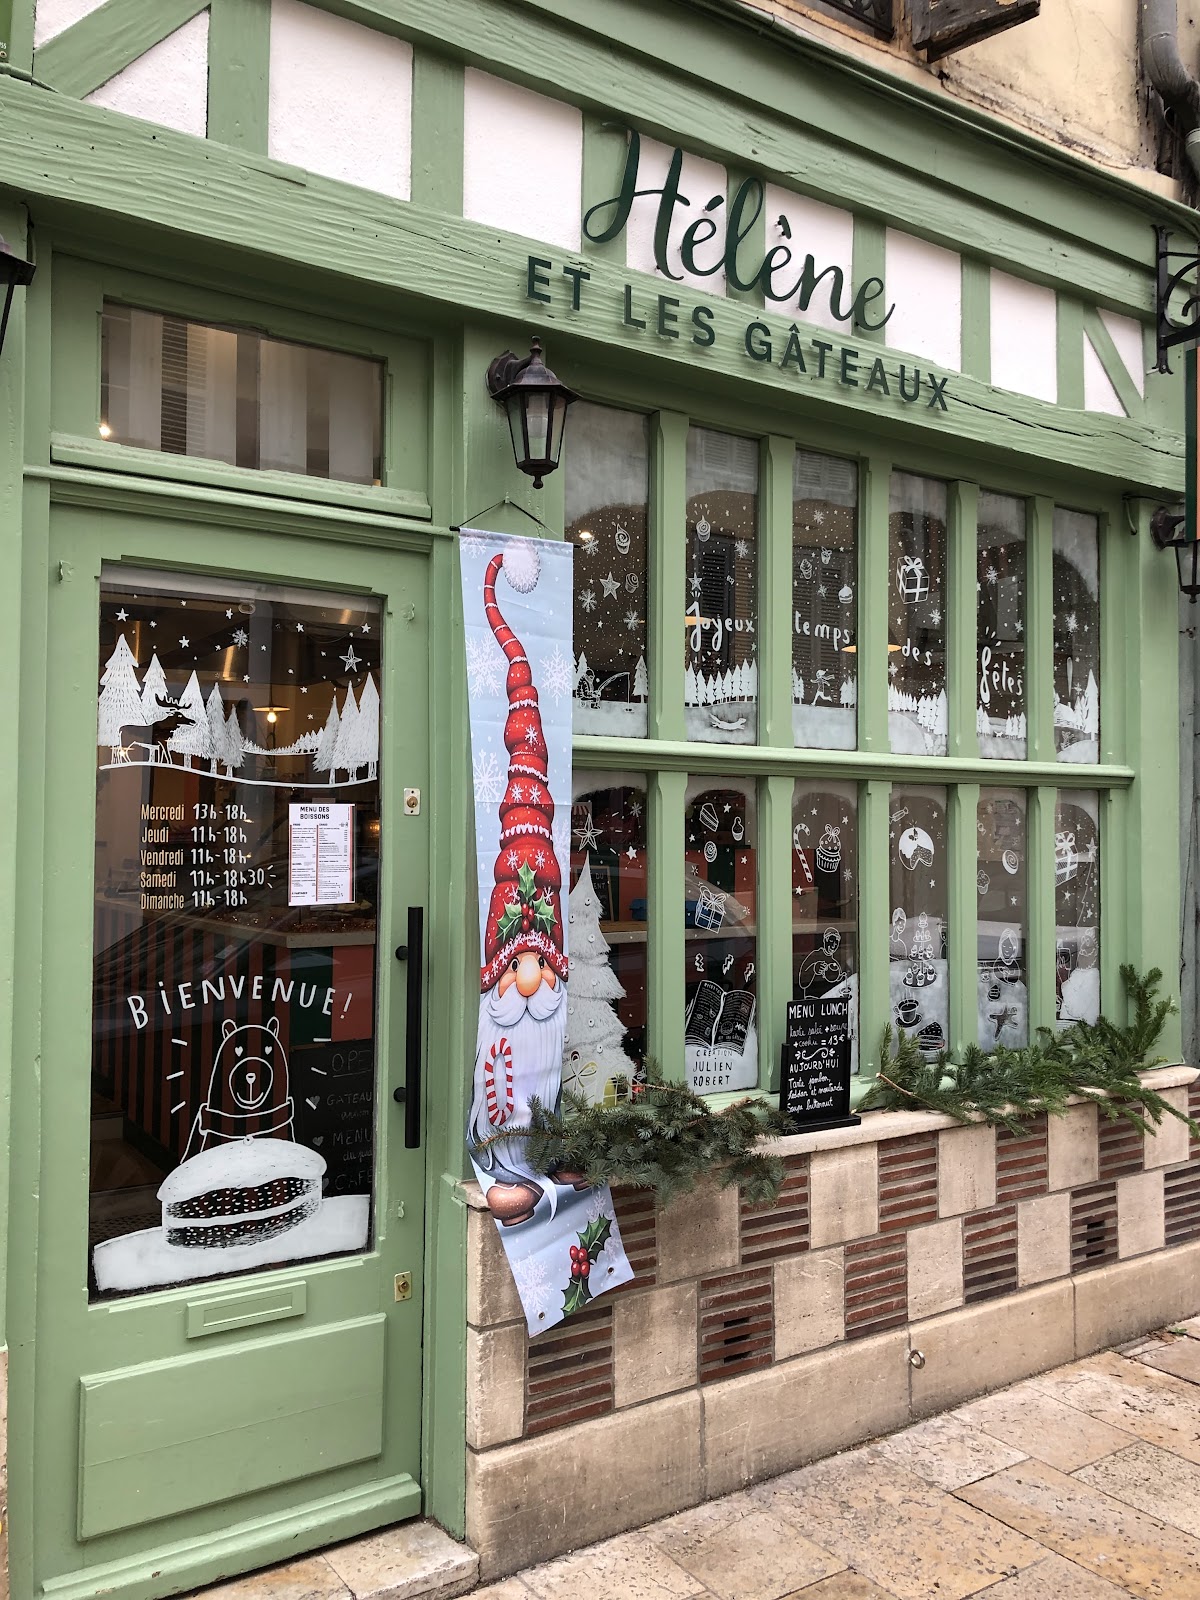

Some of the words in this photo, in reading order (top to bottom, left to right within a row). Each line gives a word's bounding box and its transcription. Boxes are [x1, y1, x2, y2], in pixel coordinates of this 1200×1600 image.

[583, 122, 895, 331] Hélène
[527, 255, 591, 311] ET
[623, 284, 716, 347] LES
[744, 322, 949, 412] GÂTEAUX
[686, 601, 755, 652] Joyeux
[794, 611, 851, 651] temps
[902, 638, 932, 666] des
[980, 646, 1024, 704] fêtes
[141, 803, 185, 820] Mercredi
[141, 826, 169, 843] Jeudi
[140, 849, 184, 866] Vendredi
[140, 871, 177, 888] Samedi
[140, 893, 185, 910] Dimanche
[789, 1003, 815, 1019] MENU
[821, 1002, 848, 1016] LUNCH
[828, 1034, 845, 1046] 13€
[693, 1057, 733, 1072] JULIEN
[693, 1075, 730, 1087] ROBERT
[788, 1077, 805, 1089] Tarte
